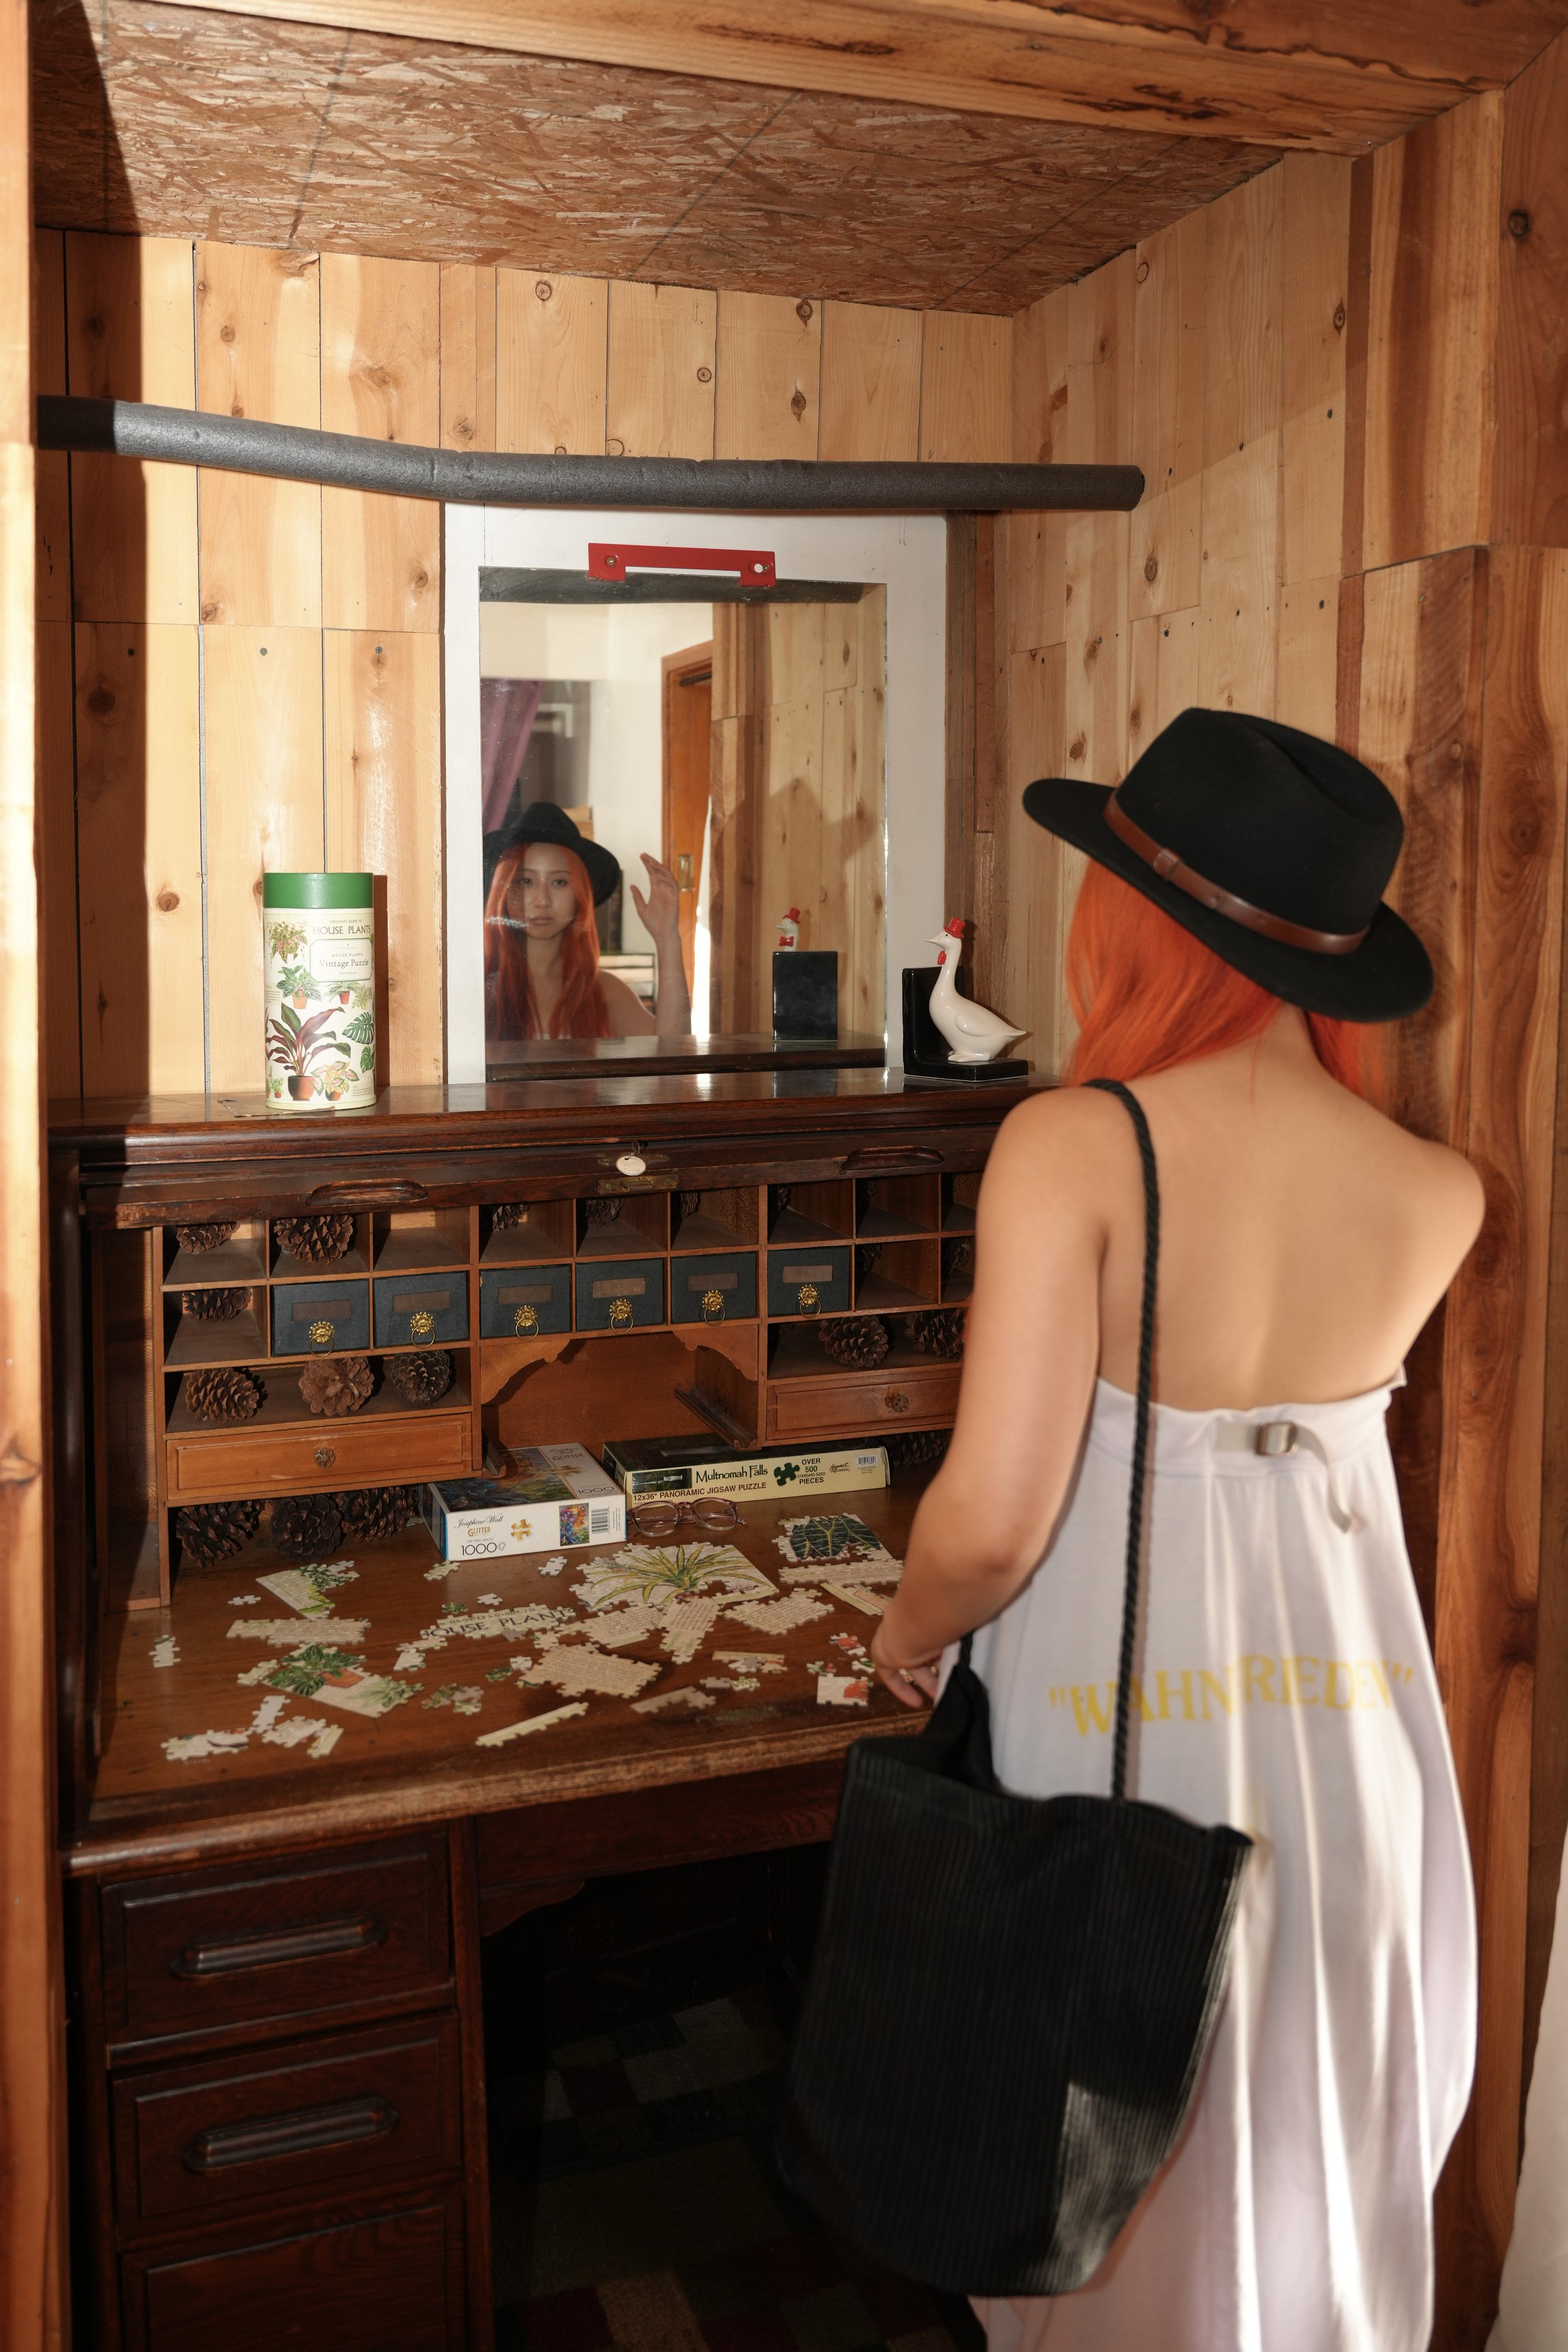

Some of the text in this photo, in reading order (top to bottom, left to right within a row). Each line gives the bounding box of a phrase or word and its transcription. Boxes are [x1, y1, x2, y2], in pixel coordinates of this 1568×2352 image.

[313, 925, 371, 935] HOUSE PLANTS
[319, 958, 369, 969] Vintage Puzzle
[696, 1465, 768, 1483] Multnomah Falls
[659, 1488, 705, 1499] PANORAMIC
[707, 1485, 736, 1494] JIGSAW
[738, 1482, 767, 1491] PUZZLE
[454, 1513, 504, 1528] Josephine Wall
[468, 1527, 490, 1537] GLITTER
[461, 1542, 497, 1556] 1000
